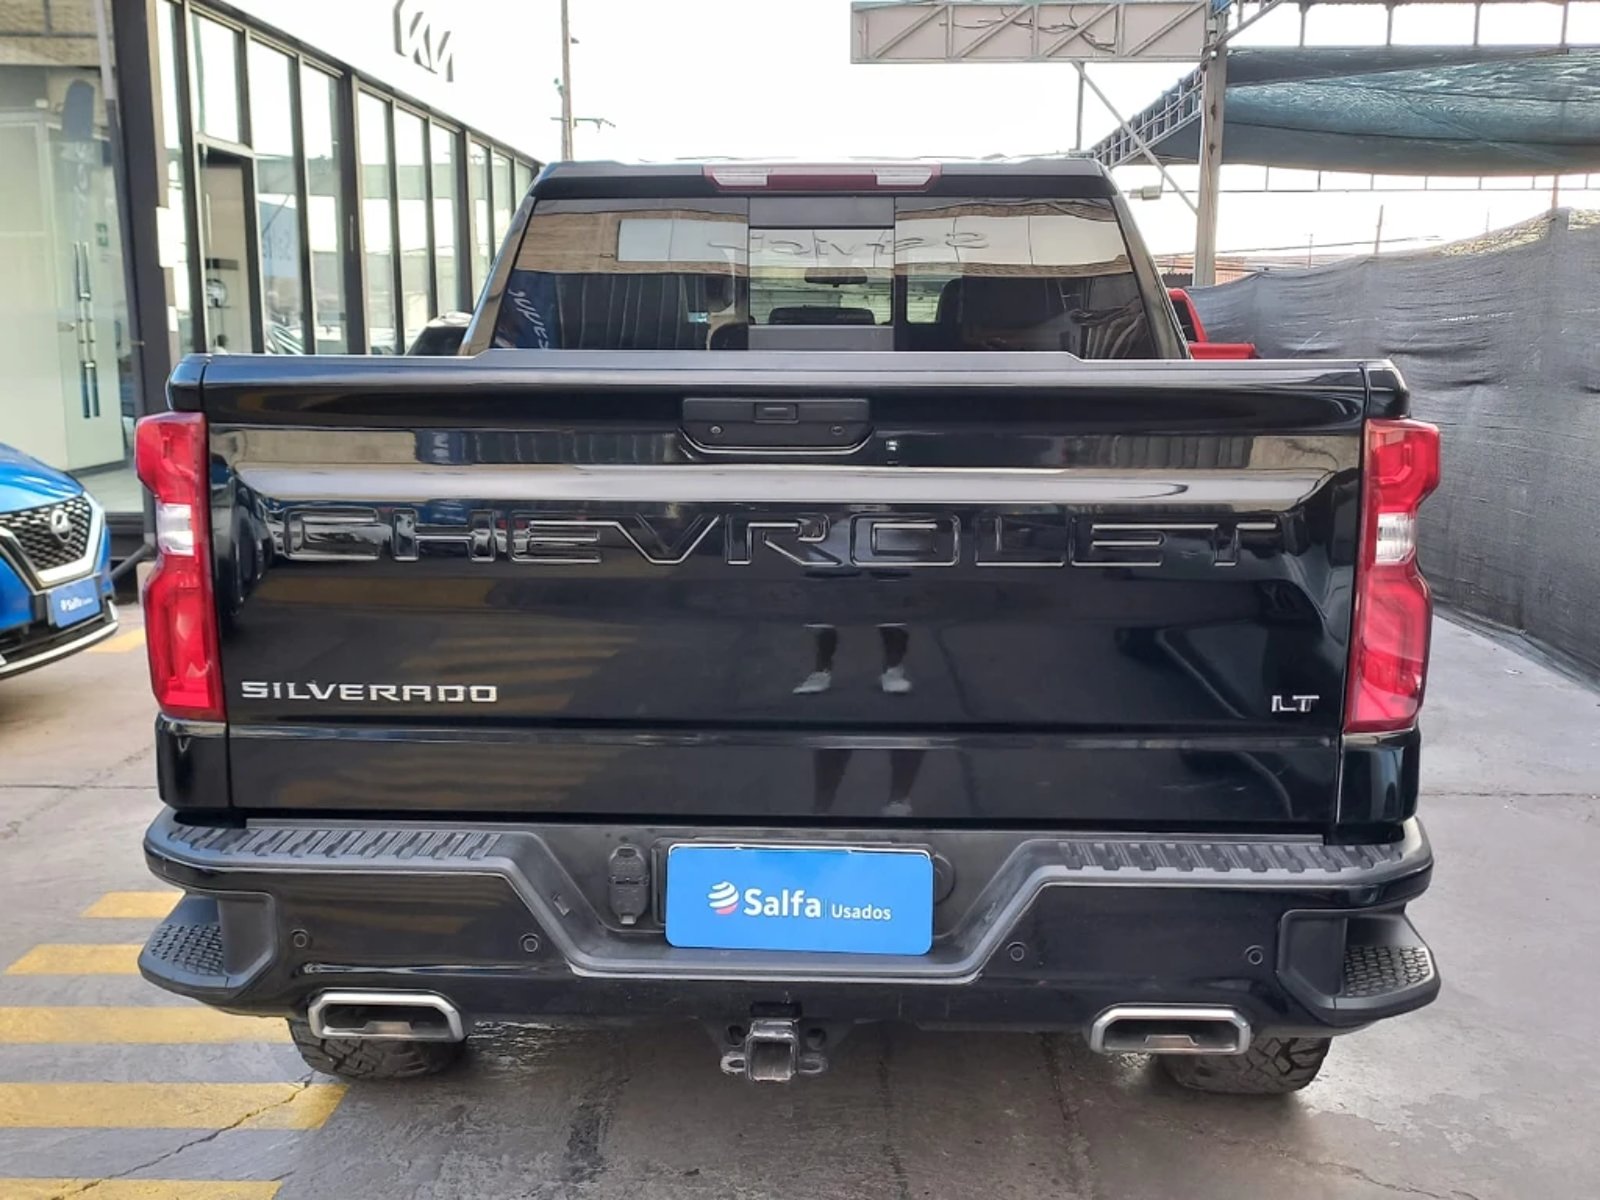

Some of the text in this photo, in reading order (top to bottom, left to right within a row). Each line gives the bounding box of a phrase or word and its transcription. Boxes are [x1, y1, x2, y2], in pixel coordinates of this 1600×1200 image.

[283, 506, 1279, 567] CHEVROLET
[241, 681, 498, 703] SILVERADO
[1271, 695, 1320, 712] LT
[743, 887, 892, 921] Salfa Usados
